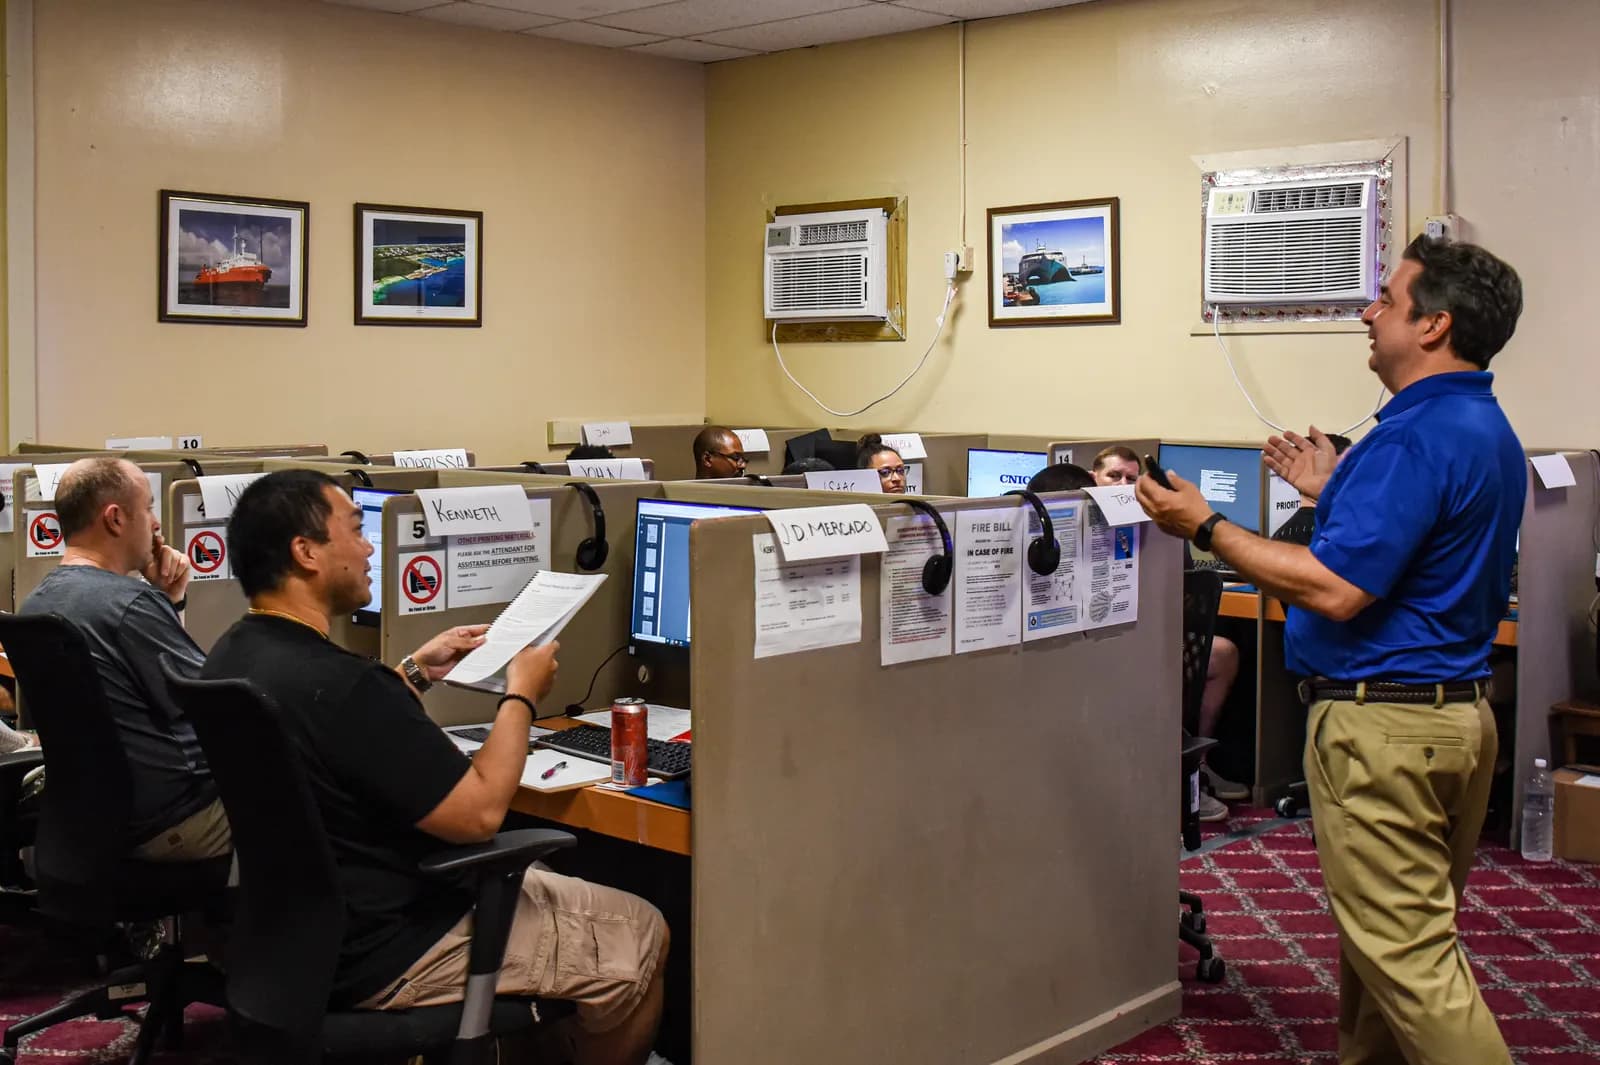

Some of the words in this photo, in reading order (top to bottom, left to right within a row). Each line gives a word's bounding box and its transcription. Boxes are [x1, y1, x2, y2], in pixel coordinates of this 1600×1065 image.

[183, 439, 199, 449] 10
[1059, 454, 1070, 464] 14
[1000, 474, 1031, 485] CNIC
[432, 498, 502, 523] KENNETH
[1276, 500, 1301, 511] PRIORIT
[412, 520, 426, 539] 5
[808, 520, 873, 537] MERCADO
[971, 522, 991, 533] FIRE
[993, 521, 1012, 532] BILL
[491, 545, 523, 555] ATTENDANT
[524, 544, 536, 552] FOR
[975, 548, 990, 556] CASE
[1000, 547, 1014, 555] FIRE
[457, 559, 491, 569] ASSISTANCE
[491, 557, 512, 566] BEFORE
